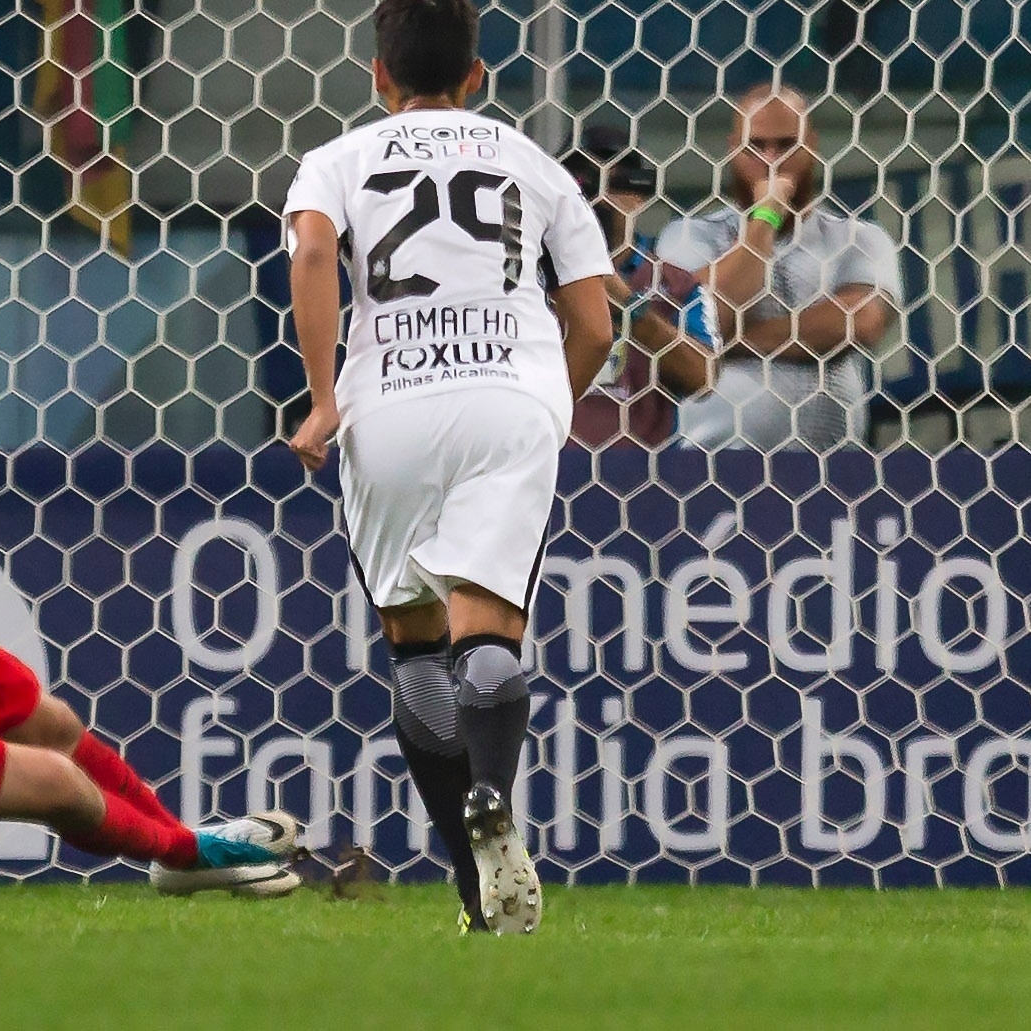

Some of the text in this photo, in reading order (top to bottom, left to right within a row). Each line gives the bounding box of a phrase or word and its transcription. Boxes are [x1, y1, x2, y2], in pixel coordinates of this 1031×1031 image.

[377, 125, 500, 142] alcatel
[382, 140, 434, 161] A5
[361, 169, 523, 305] 29
[375, 307, 518, 345] CAMACHO
[381, 342, 515, 379] FOXLUX
[381, 367, 520, 396] Pilhas Alcalinas
[345, 512, 1009, 674] médio
